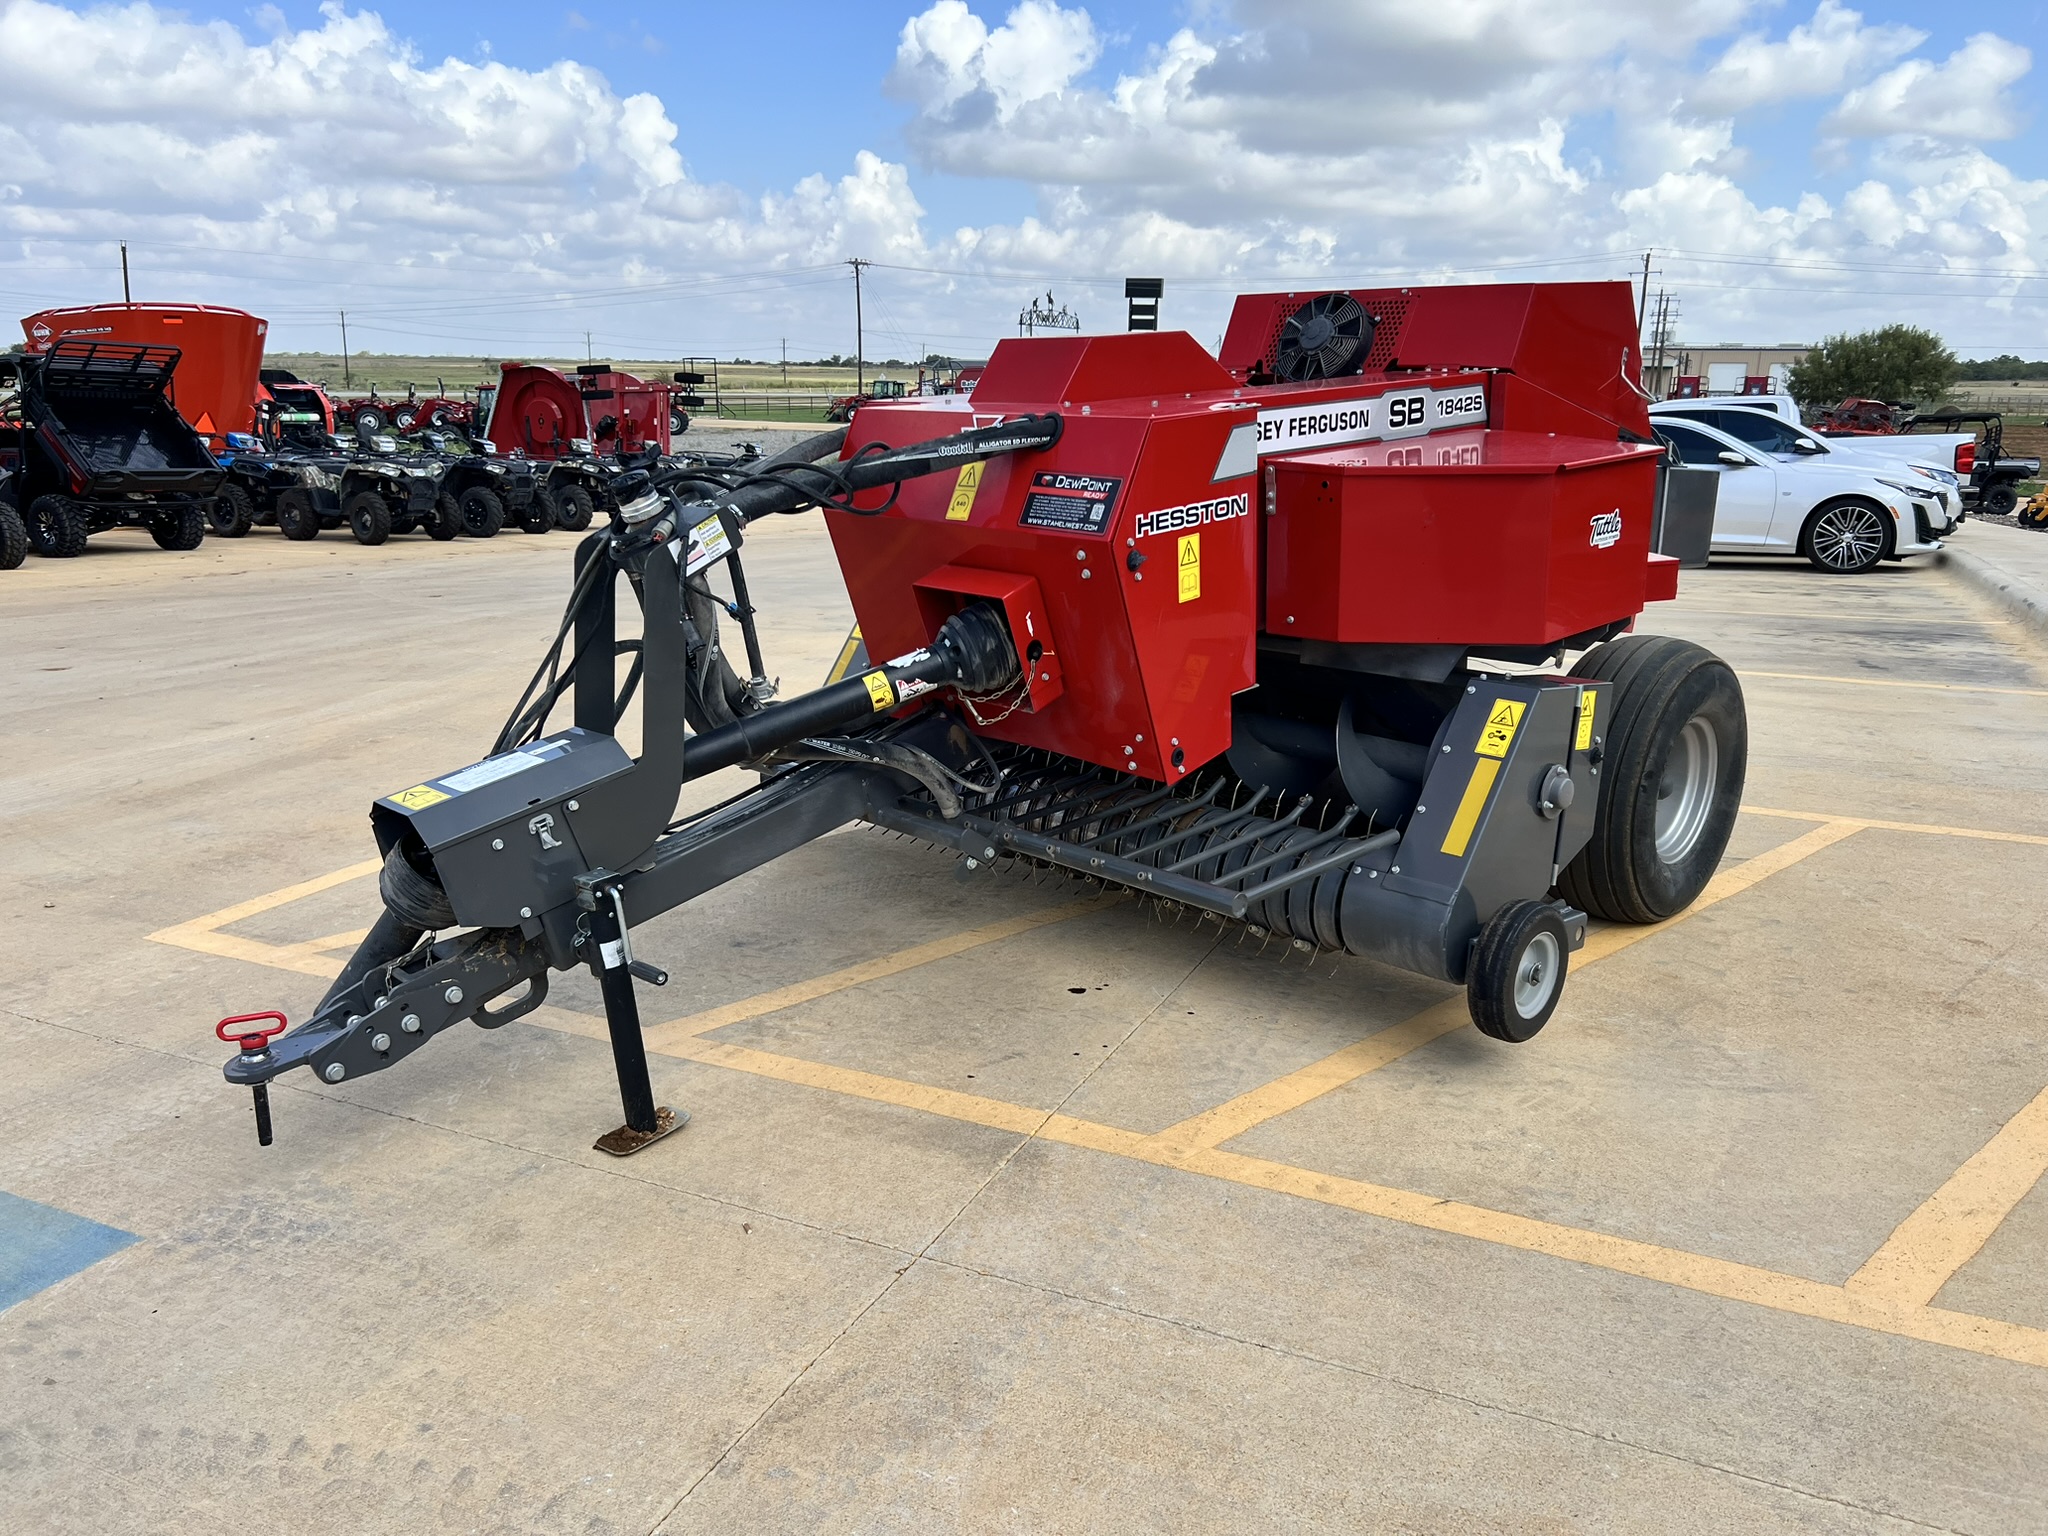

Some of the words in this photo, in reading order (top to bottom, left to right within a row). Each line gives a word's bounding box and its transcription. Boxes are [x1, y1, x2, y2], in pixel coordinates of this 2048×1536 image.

[1289, 409, 1370, 438] FERGUSON
[1389, 396, 1426, 430] SB
[1436, 394, 1484, 418] 1842S
[978, 439, 1012, 448] ALLIGATOR
[1082, 491, 1106, 499] READY
[1136, 493, 1249, 537] HESSTON
[1590, 509, 1621, 545] Tuttle
